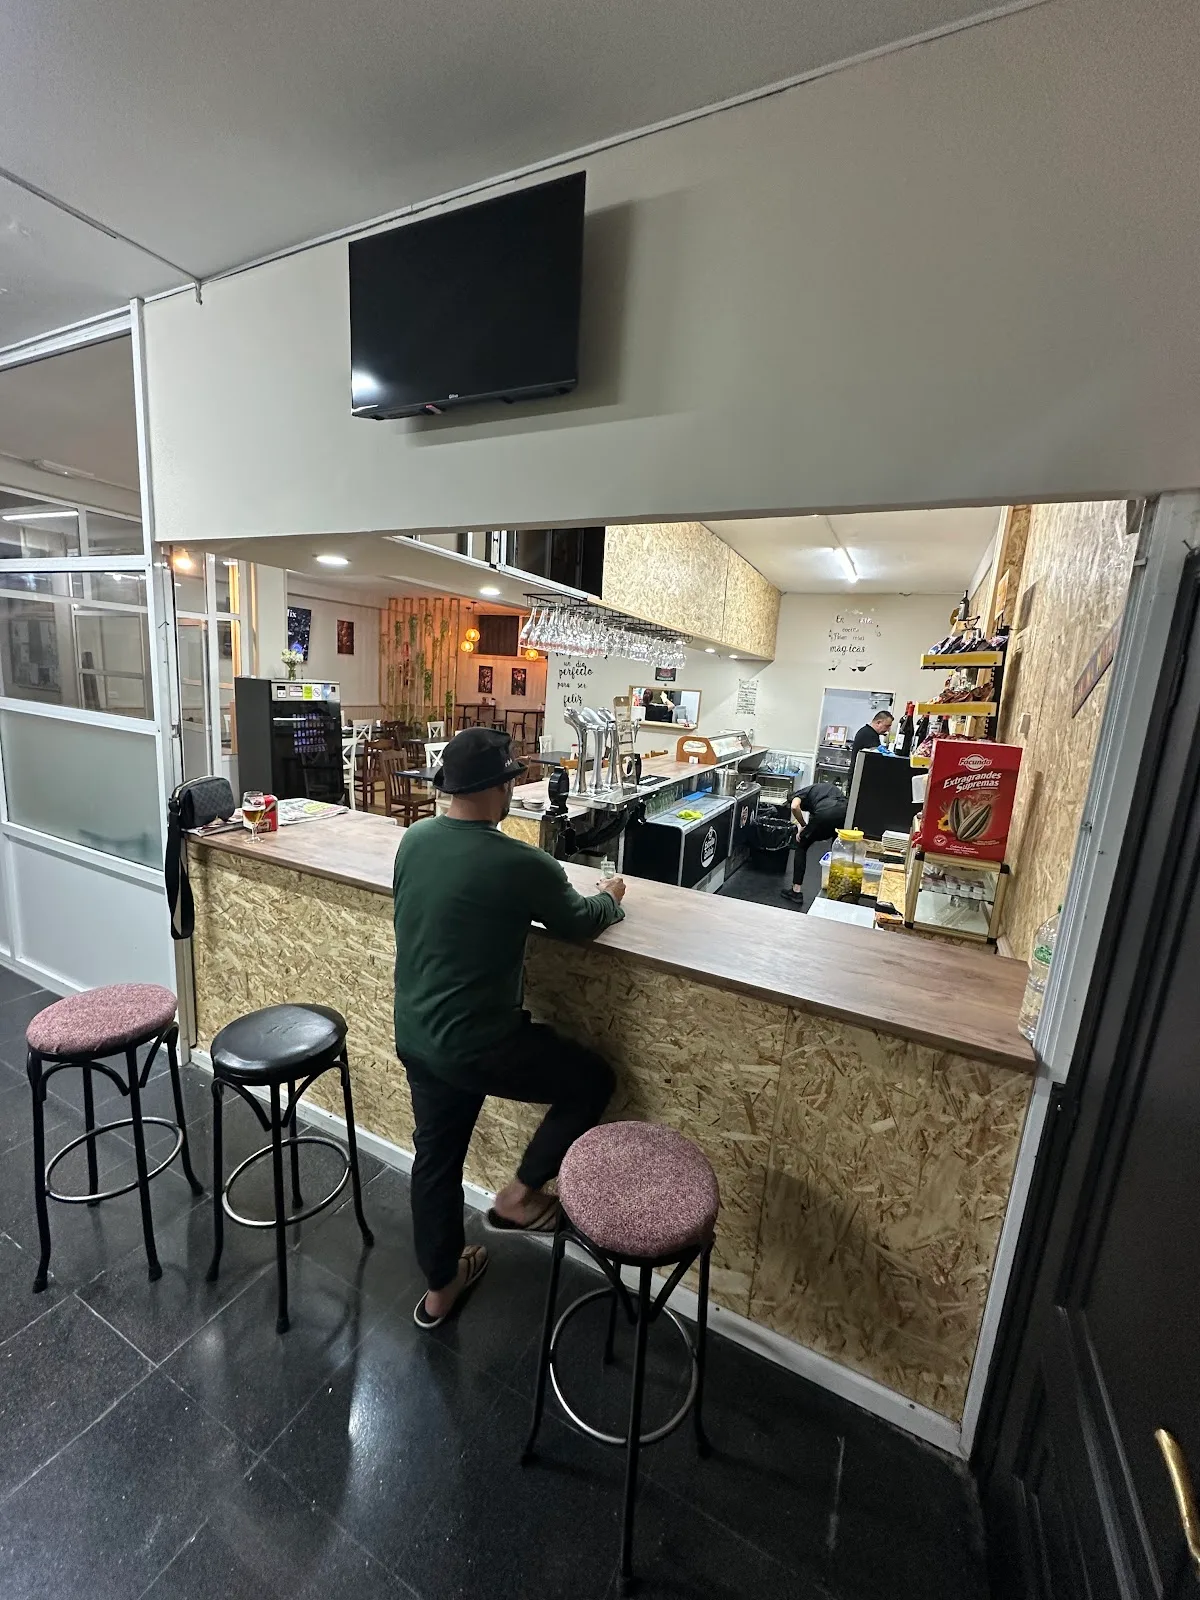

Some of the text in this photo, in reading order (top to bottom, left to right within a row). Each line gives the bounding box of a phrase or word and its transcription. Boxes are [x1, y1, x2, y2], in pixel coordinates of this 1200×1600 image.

[559, 665, 593, 680] perfecto
[557, 682, 570, 690] para
[563, 693, 583, 708] feliz
[958, 756, 992, 768] Facundo
[943, 770, 1002, 789] Extragrandes
[955, 779, 999, 793] Supremas
